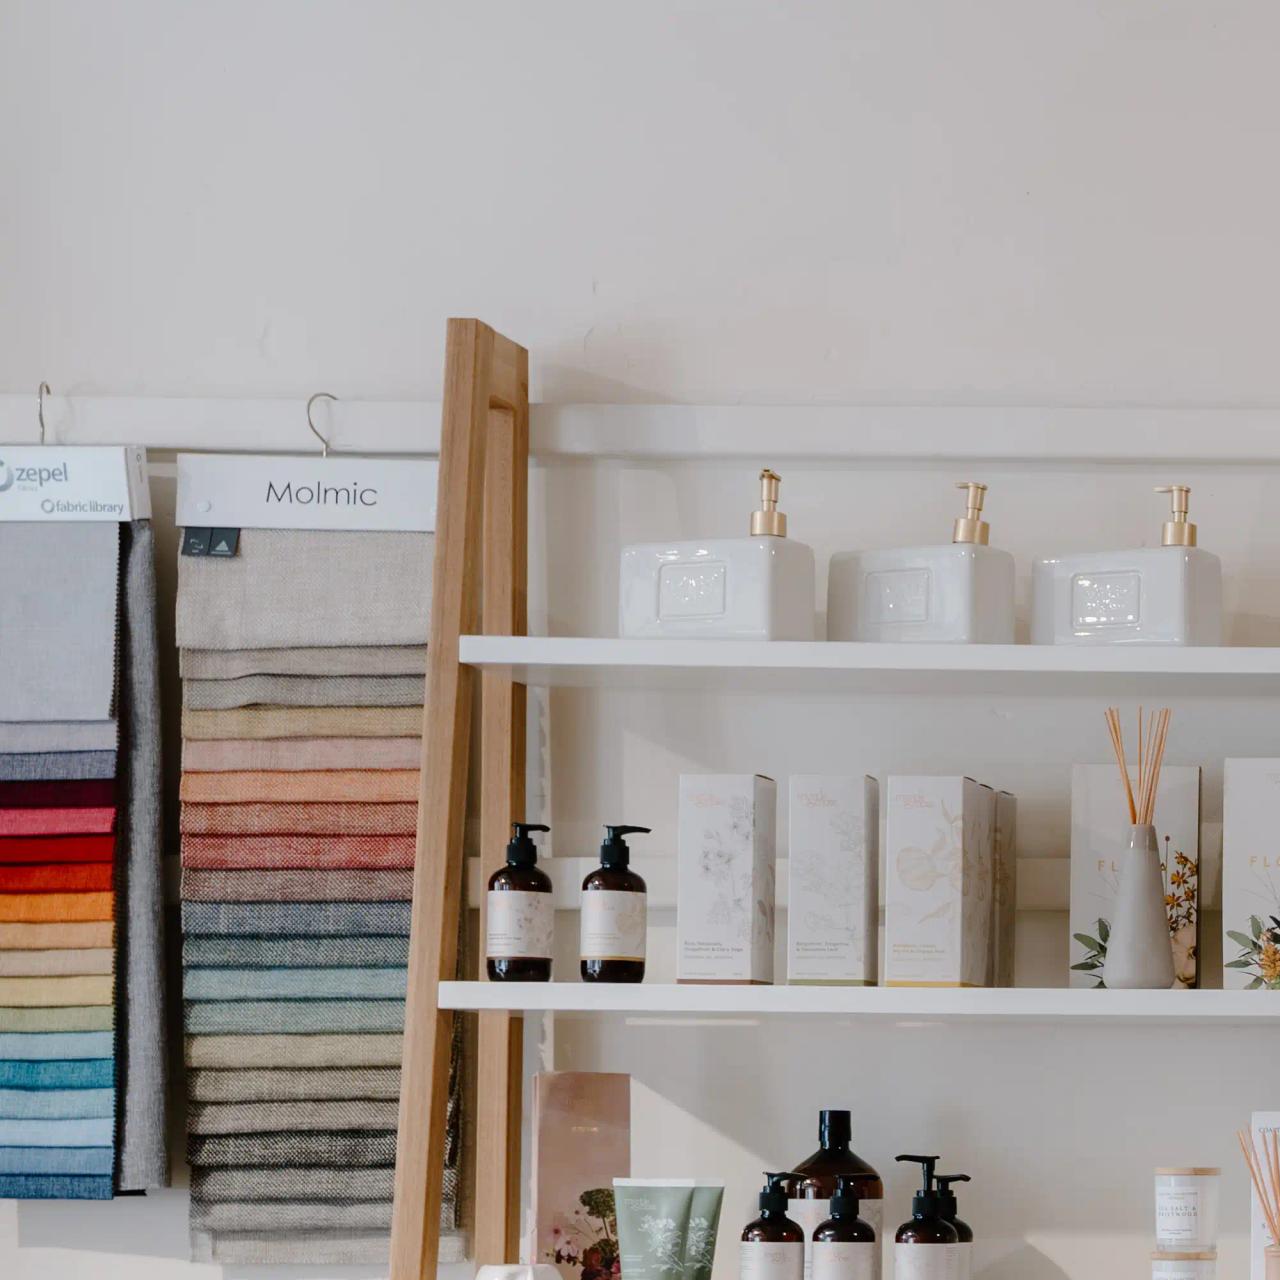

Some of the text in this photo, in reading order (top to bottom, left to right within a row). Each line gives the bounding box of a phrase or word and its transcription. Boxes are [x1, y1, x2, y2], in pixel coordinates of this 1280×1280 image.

[15, 462, 69, 488] zepel
[266, 480, 378, 506] Molmic
[56, 500, 124, 515] fabric library
[1098, 860, 1167, 873] FLA
